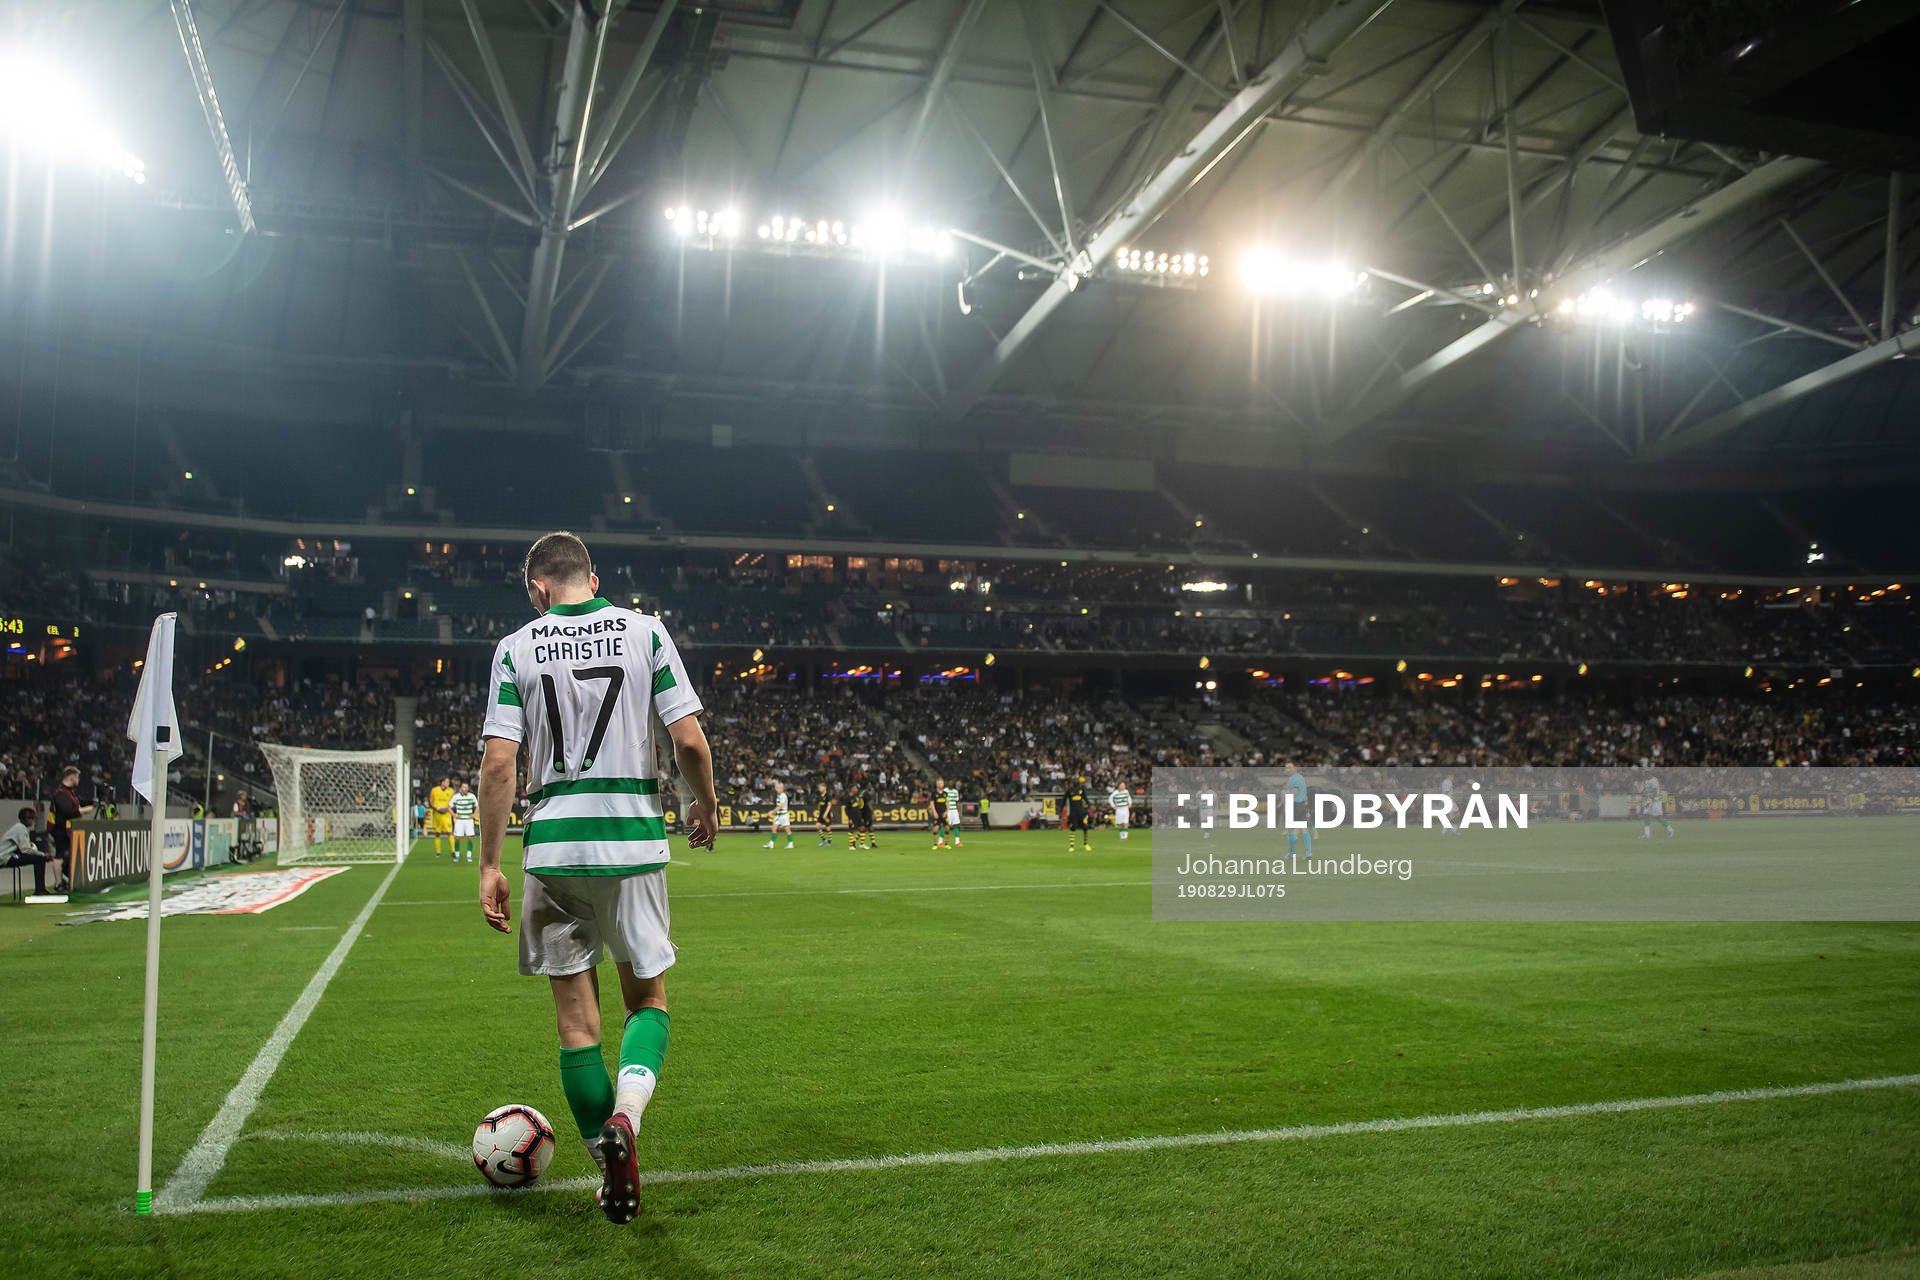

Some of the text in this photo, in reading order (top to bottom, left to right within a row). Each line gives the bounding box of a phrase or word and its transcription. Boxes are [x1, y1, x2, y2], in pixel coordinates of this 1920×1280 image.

[531, 618, 627, 640] MAGNERS
[534, 637, 624, 664] CHRISTIE
[541, 665, 625, 774] 17
